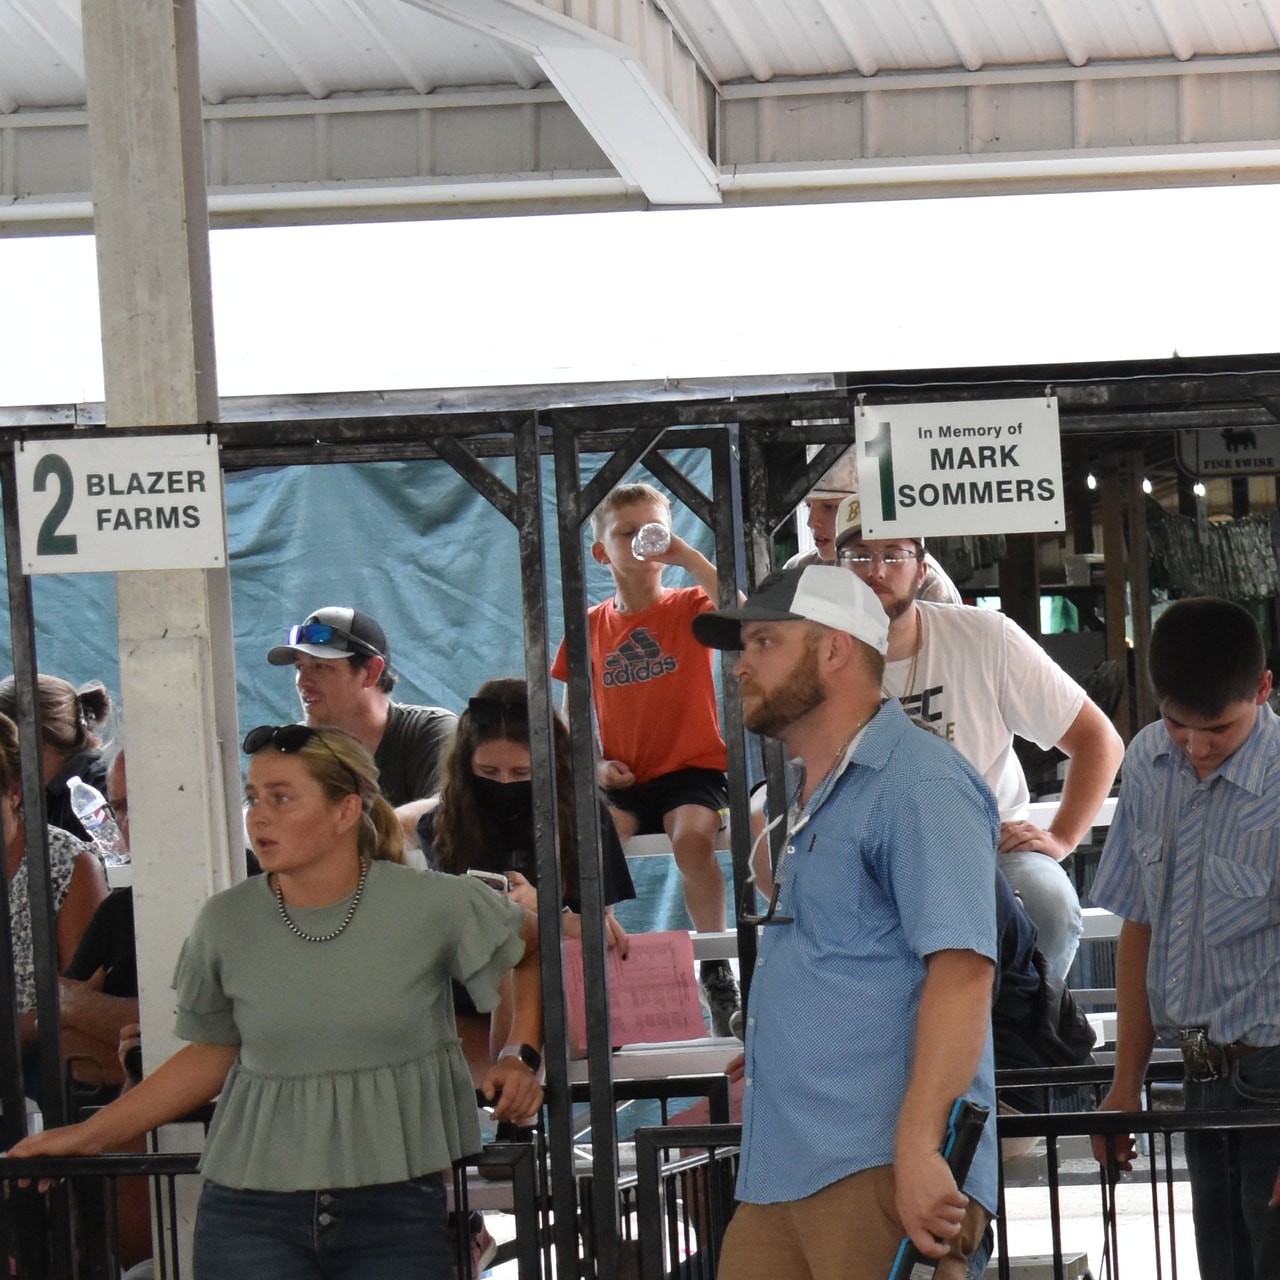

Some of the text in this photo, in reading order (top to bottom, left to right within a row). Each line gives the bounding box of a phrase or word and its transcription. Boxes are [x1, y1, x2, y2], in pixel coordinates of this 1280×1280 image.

[918, 422, 1023, 439] In Memory of
[930, 444, 1020, 471] MARK
[1235, 457, 1275, 469] SWINE
[86, 470, 207, 497] BLAZER
[864, 421, 897, 522] 1
[33, 453, 78, 556] 2
[899, 478, 1055, 508] SOMMERS
[96, 505, 201, 531] FARMS
[602, 655, 679, 688] adidas
